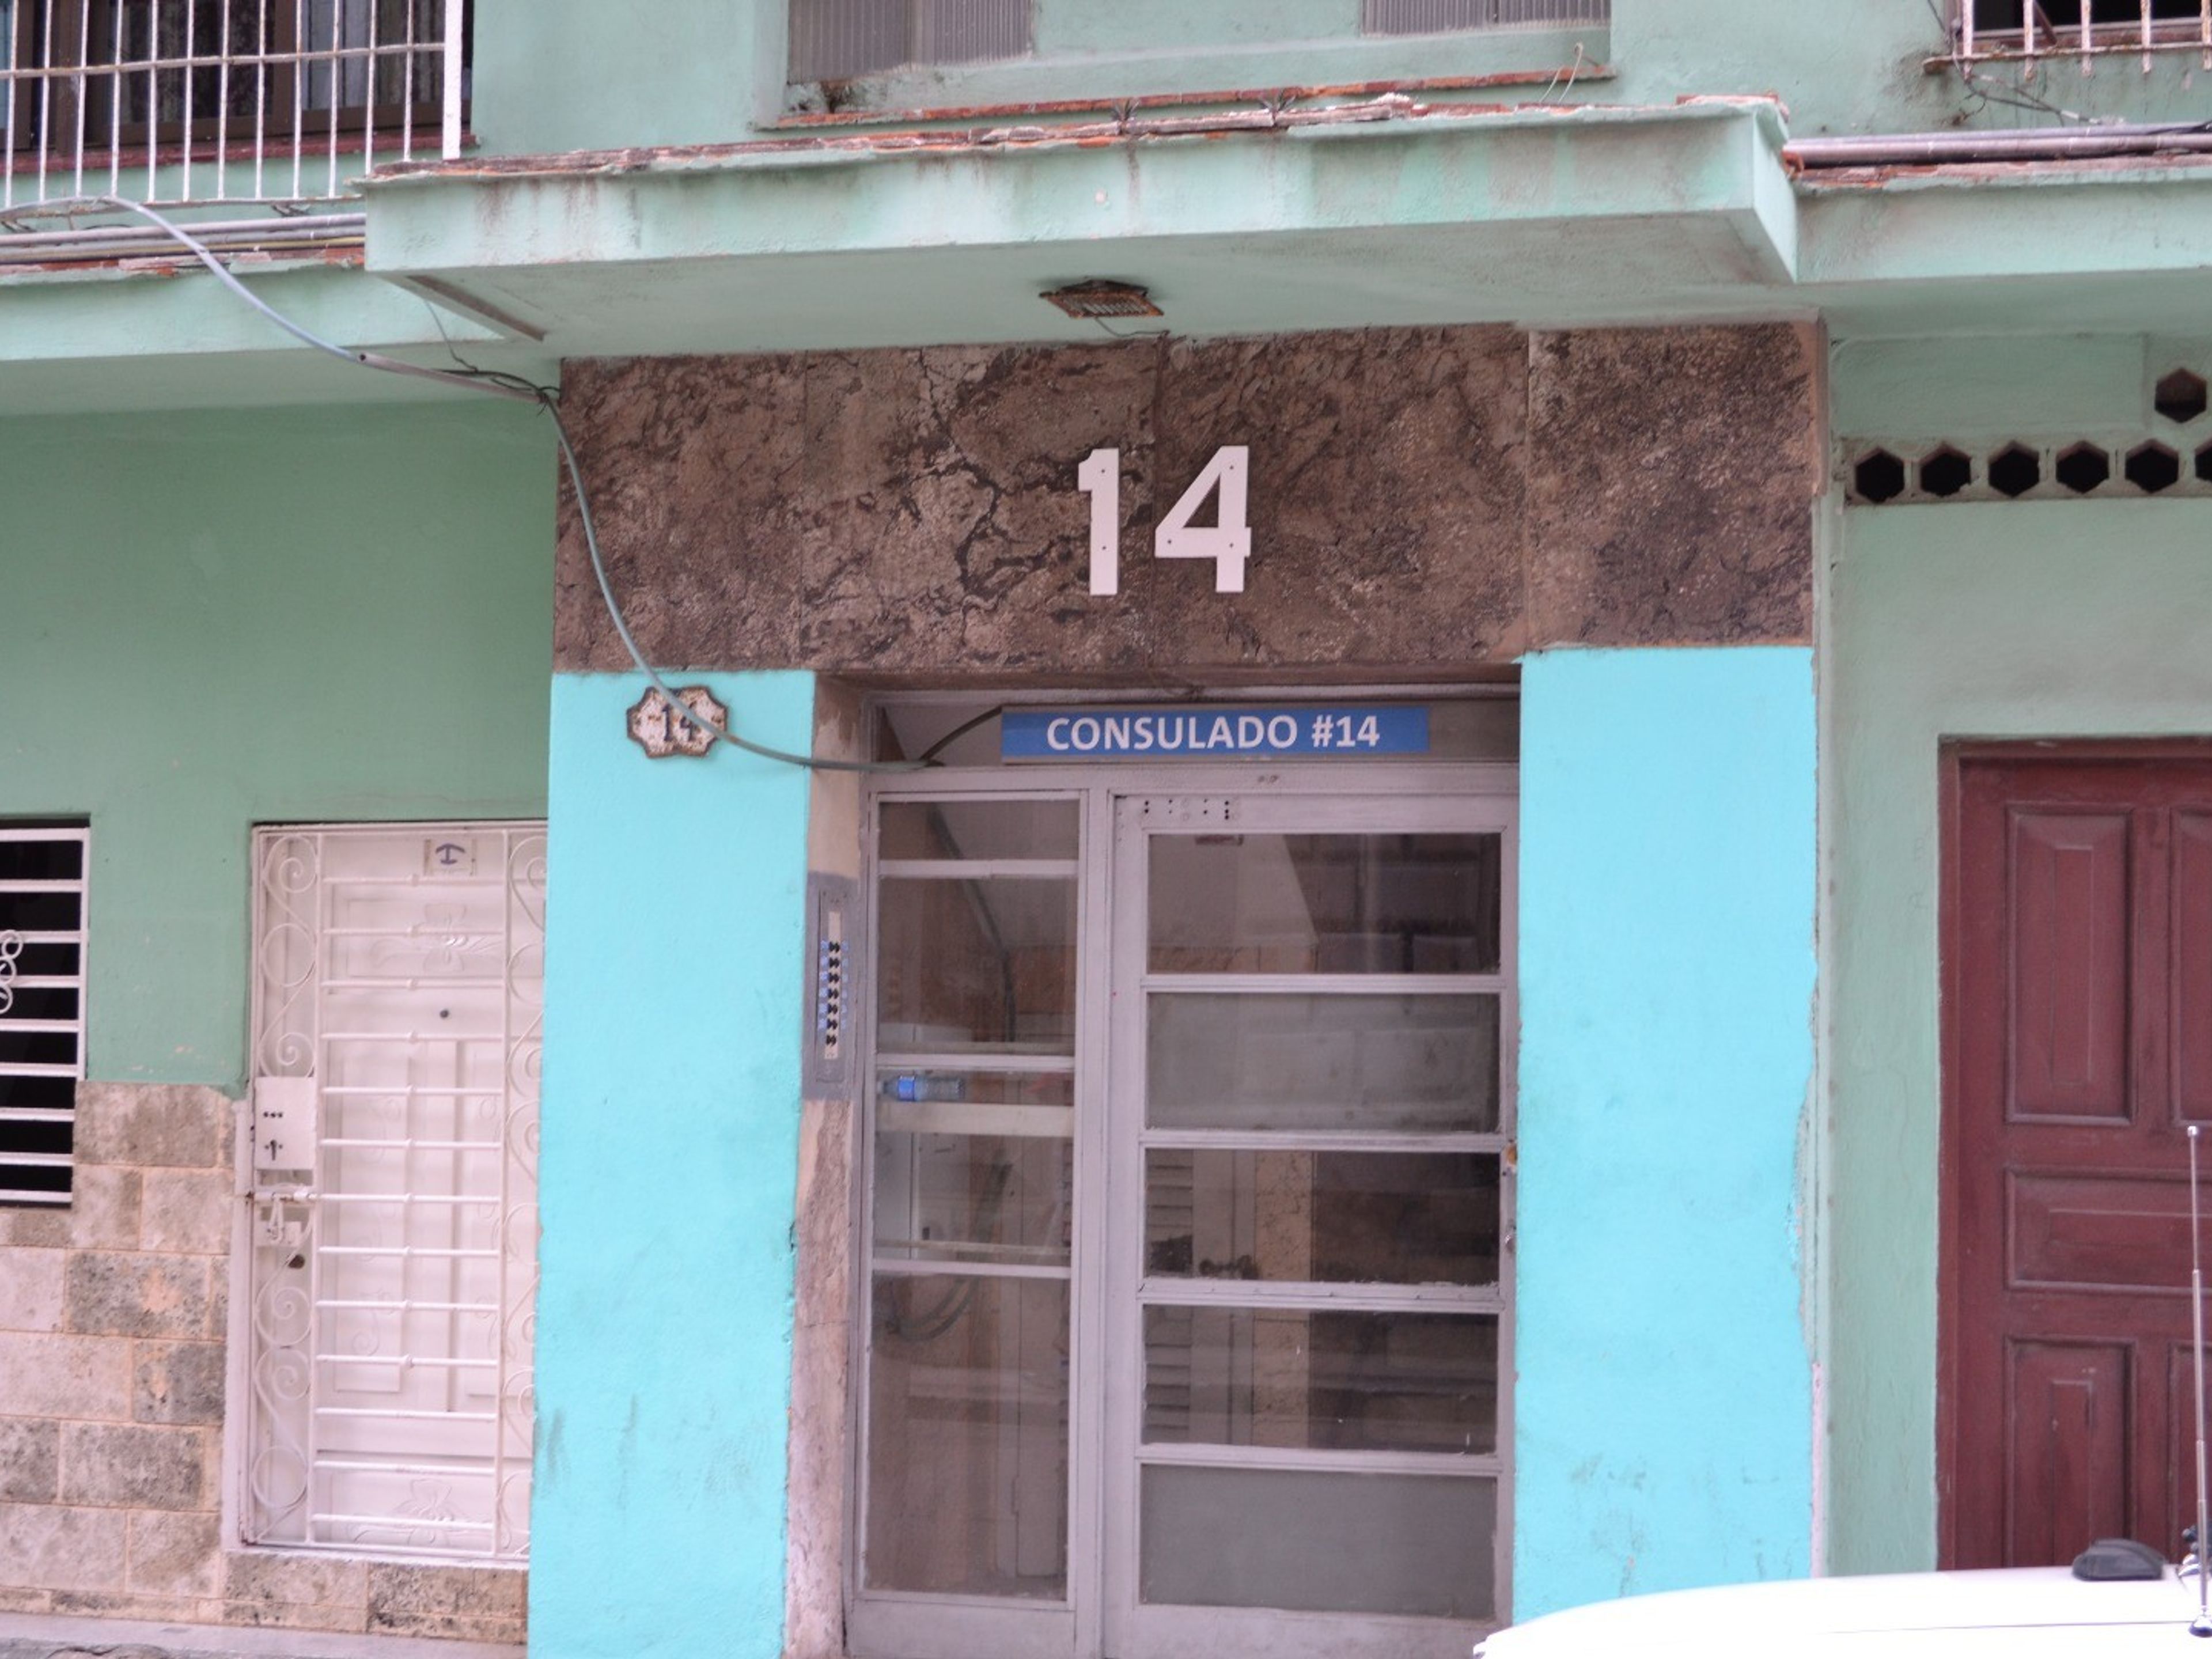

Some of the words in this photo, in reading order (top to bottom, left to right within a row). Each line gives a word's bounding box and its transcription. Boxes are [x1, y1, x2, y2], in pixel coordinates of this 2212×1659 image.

[1078, 445, 1251, 596] 14
[1047, 715, 1297, 751] CONSULADO
[1311, 714, 1380, 748] #14
